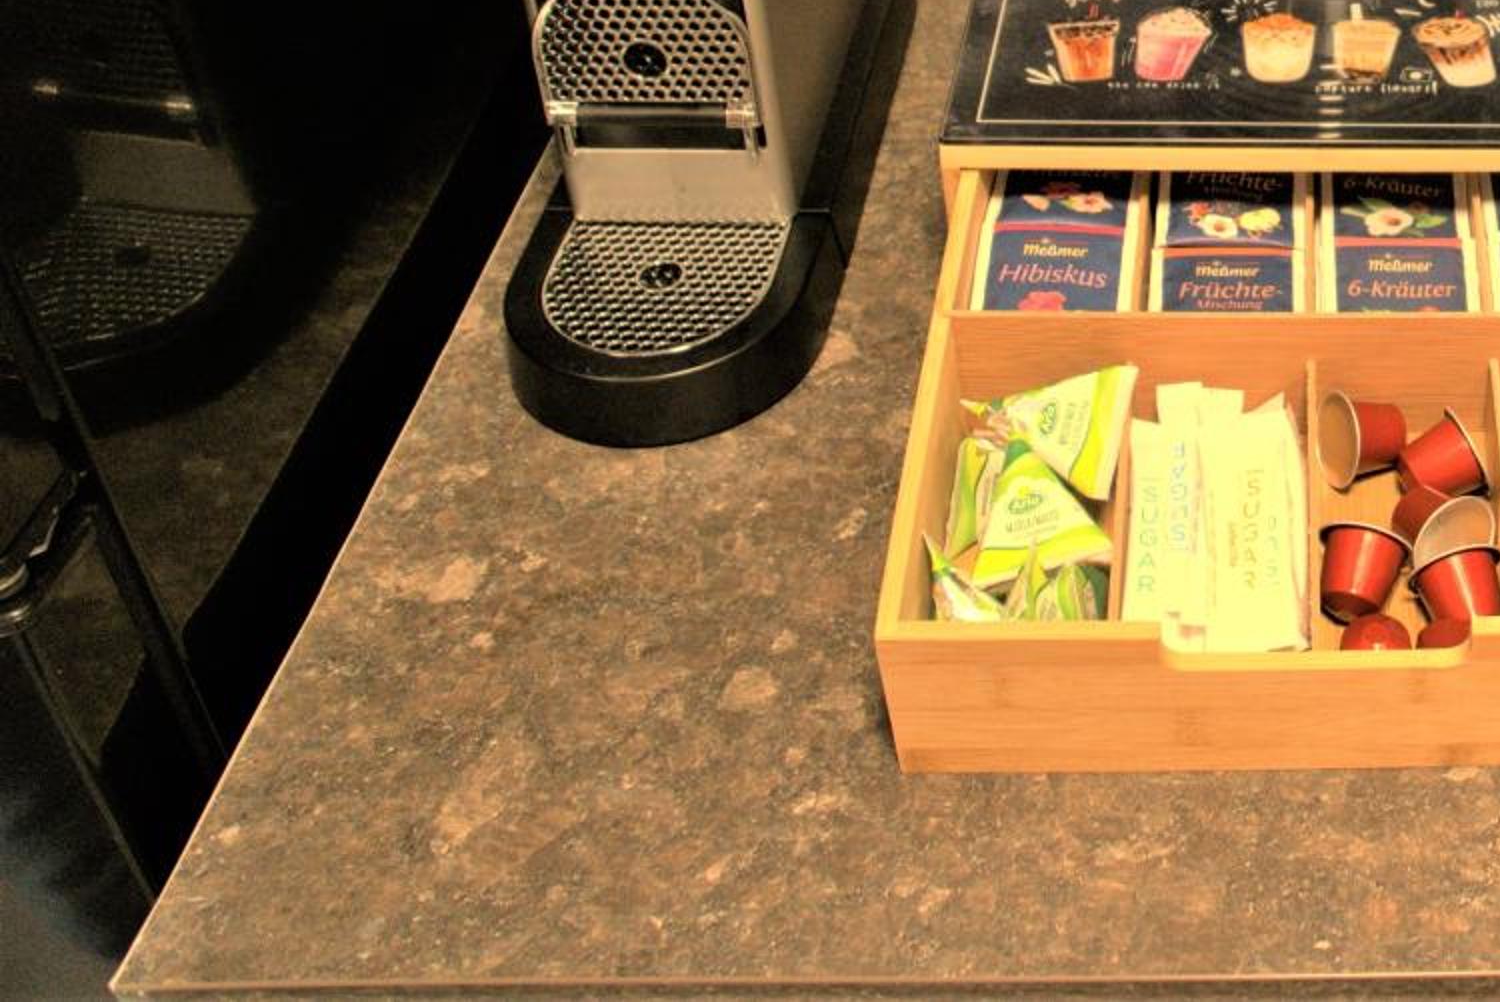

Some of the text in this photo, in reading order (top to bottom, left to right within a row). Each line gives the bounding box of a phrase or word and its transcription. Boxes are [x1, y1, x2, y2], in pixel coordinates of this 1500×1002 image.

[998, 263, 1108, 290] Hibiskus
[1179, 280, 1283, 300] Früchte-
[1347, 279, 1456, 299] 6-Kräuter
[1136, 484, 1160, 593] SUGAR
